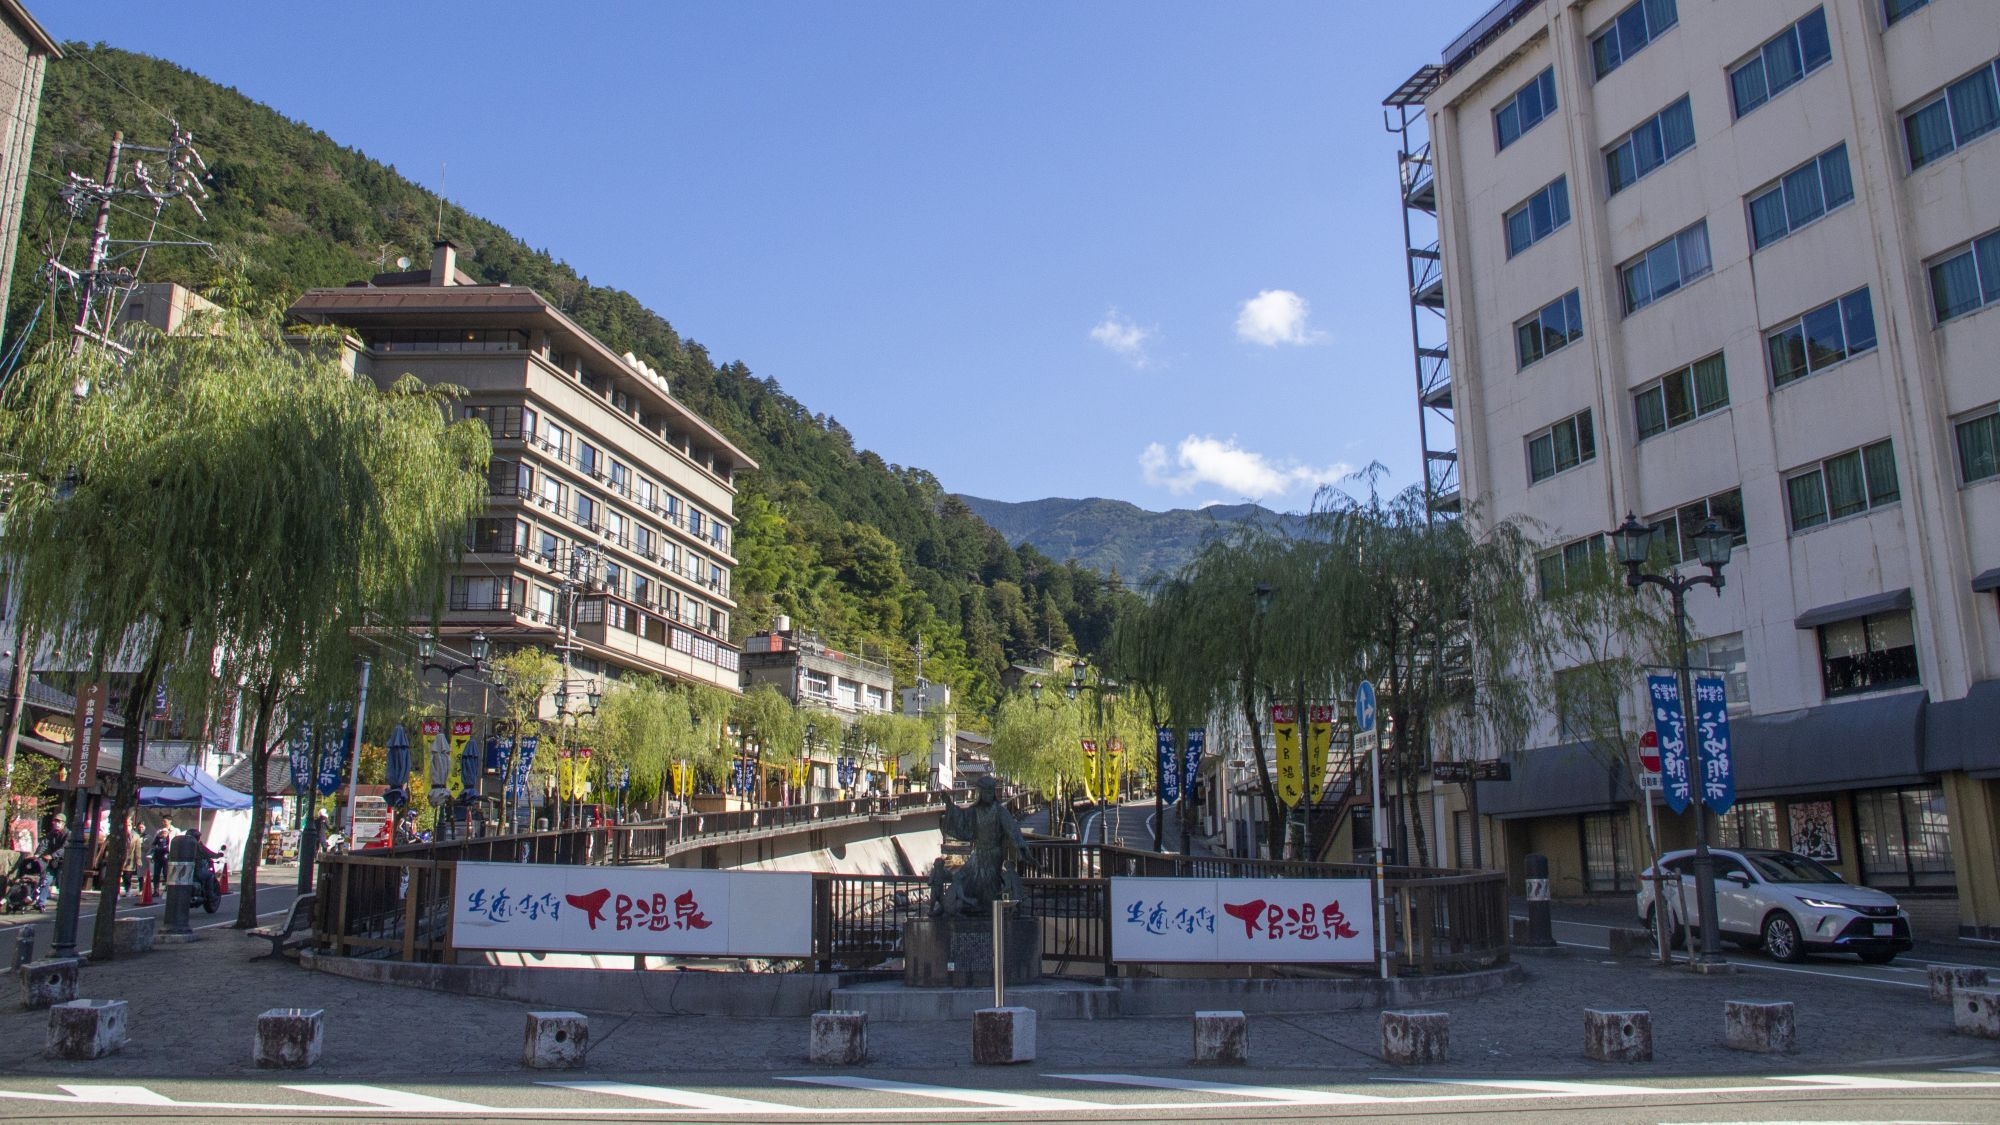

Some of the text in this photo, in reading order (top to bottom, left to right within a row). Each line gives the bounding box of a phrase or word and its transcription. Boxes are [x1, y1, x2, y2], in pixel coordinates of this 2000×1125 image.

[1278, 727, 1297, 798] 下呂温泉
[1656, 707, 1689, 800] いでゆ朝市
[565, 888, 713, 931] 下呂温泉
[1223, 899, 1360, 940] 下呂温泉
